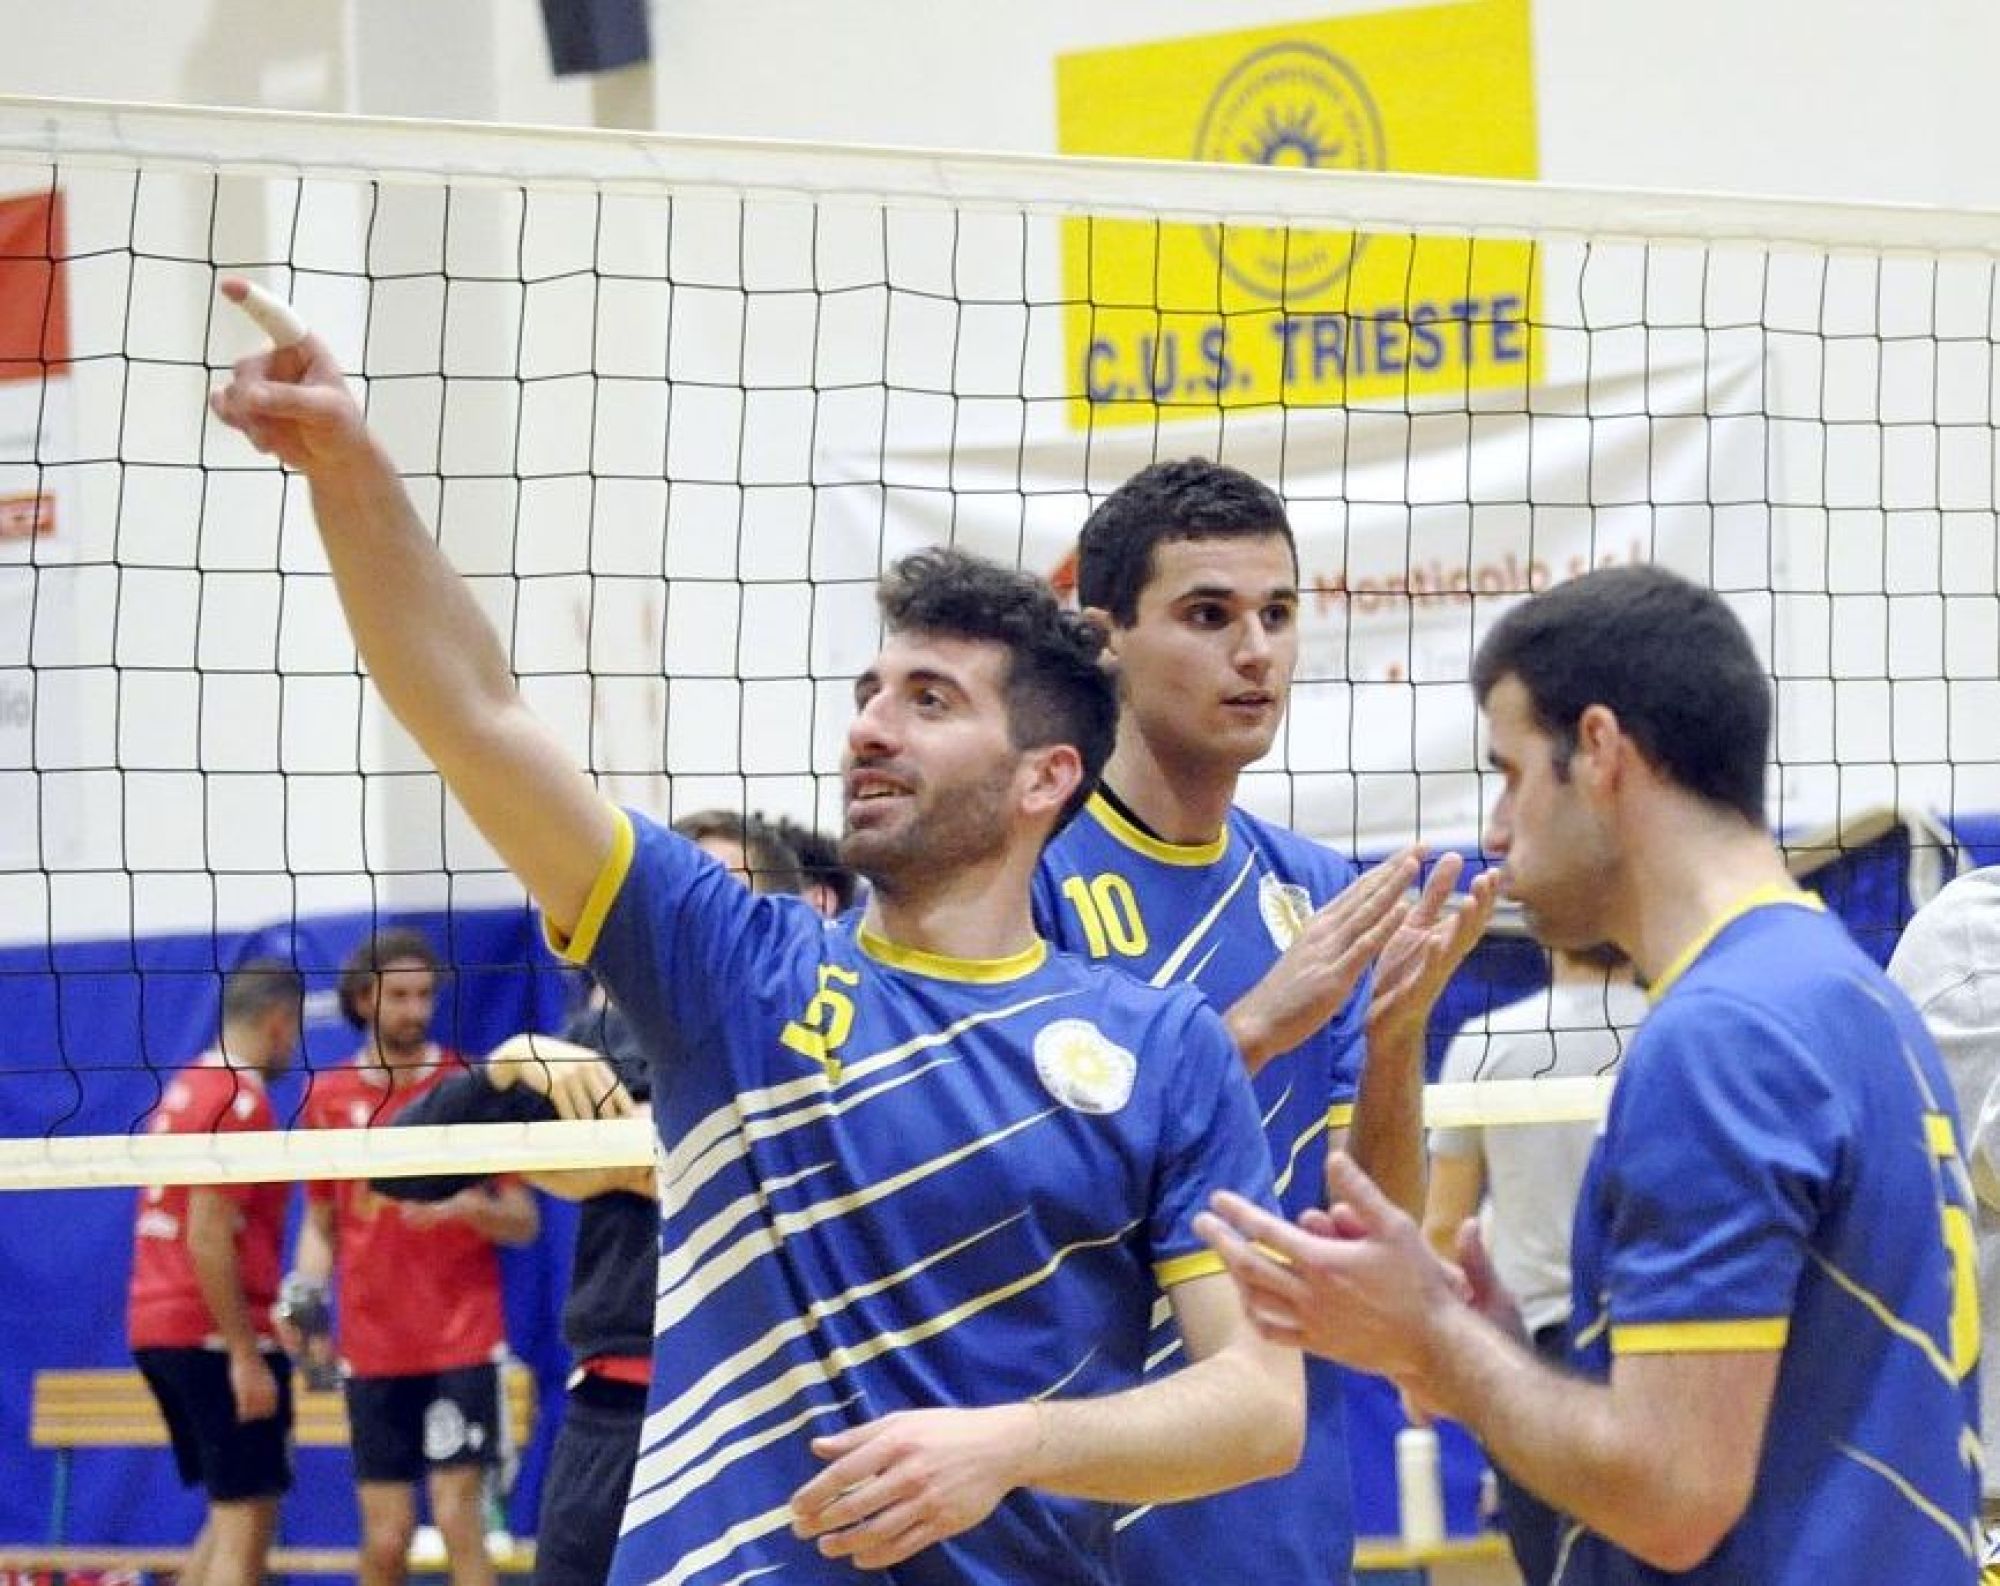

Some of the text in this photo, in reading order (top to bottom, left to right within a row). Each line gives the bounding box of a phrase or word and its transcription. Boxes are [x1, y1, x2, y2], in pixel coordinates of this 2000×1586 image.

[1085, 297, 1523, 408] C.U.S. TRIESTE
[1062, 873, 1148, 958] 10
